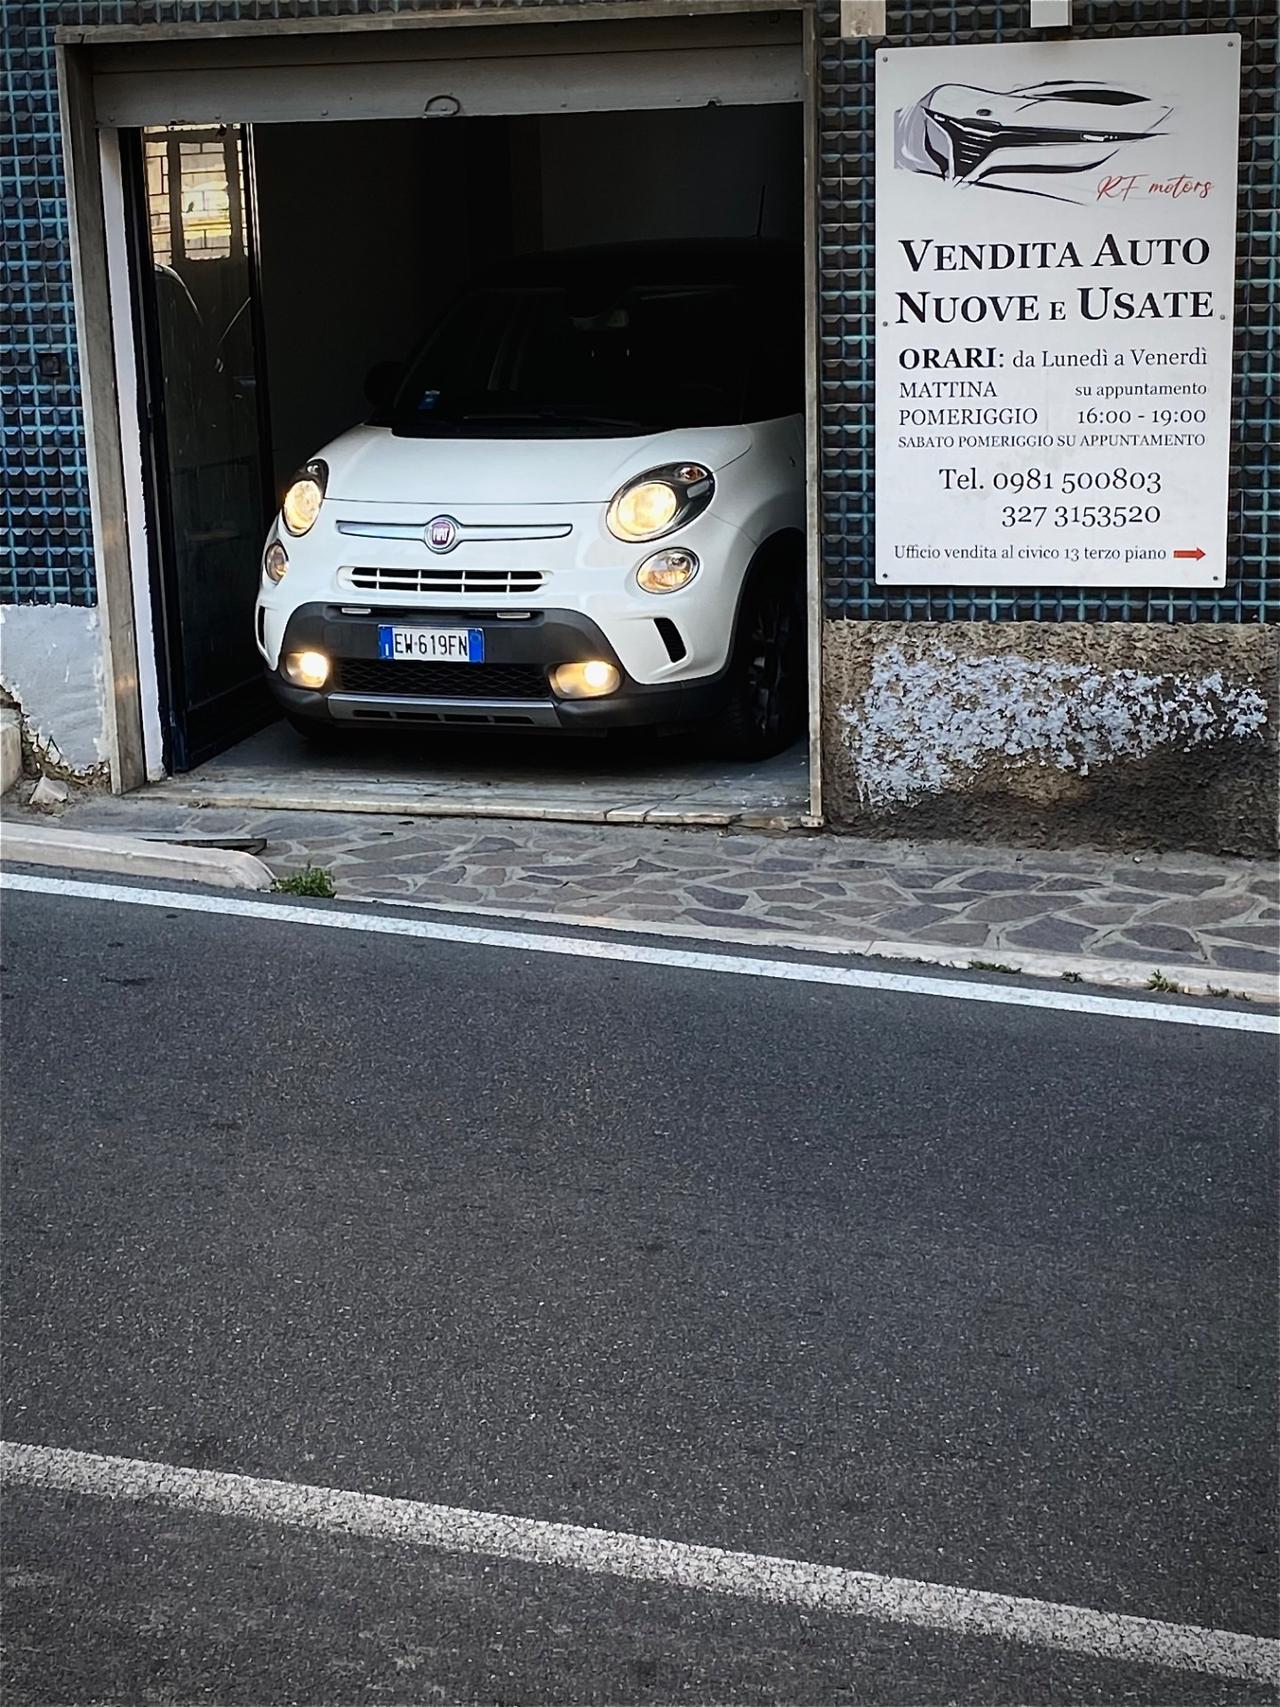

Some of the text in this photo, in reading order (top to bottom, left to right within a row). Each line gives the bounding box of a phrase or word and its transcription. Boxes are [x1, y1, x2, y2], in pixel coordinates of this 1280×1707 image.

[1096, 174, 1214, 201] RF motors
[898, 233, 1210, 272] VENDITA AUTO
[895, 286, 1215, 324] NUOVE E USATE
[899, 347, 1208, 369] ORARI: da Lunedì a Venerdì
[899, 381, 1208, 400] MATTINA su appuntamento
[899, 408, 1038, 426] POMERIGGIO
[1078, 408, 1133, 424] 16:00
[1151, 408, 1208, 427] 19:00
[898, 434, 1206, 448] SABATO POMERIGGIO SU APPUNTAMENTO
[939, 466, 1161, 495] Tel. 0981 500803
[1002, 505, 1160, 528] 327 3153520
[894, 544, 1166, 563] Ufficio vendita al civico 13 terzo piano
